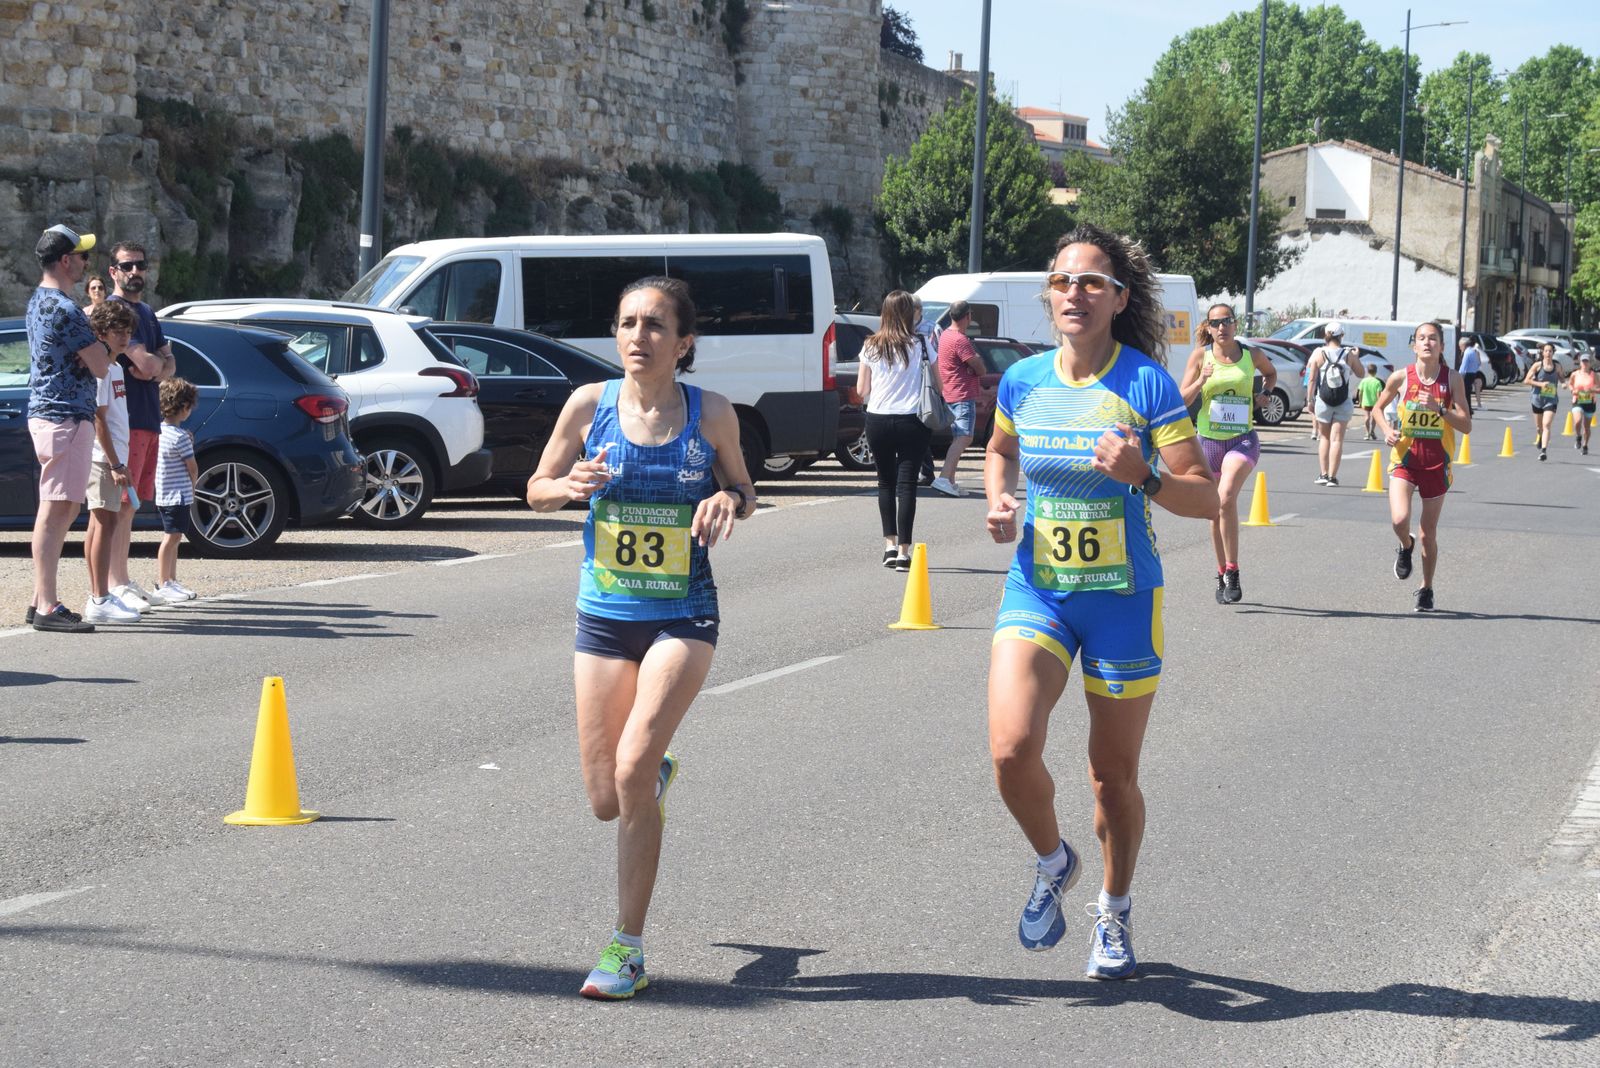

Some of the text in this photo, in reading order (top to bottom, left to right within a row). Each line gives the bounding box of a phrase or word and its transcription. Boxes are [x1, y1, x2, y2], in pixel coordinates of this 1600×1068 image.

[1222, 412, 1235, 422] ANA
[1408, 412, 1440, 427] 402
[622, 506, 678, 517] FUNDACION
[1055, 502, 1111, 511] FUNDACION
[622, 515, 678, 525] CAJA RURAL
[1055, 511, 1111, 519] CAJA RURAL
[616, 530, 665, 568] 83
[1052, 526, 1100, 562] 36
[1057, 572, 1121, 584] CAJA RURAL
[617, 578, 682, 590] CAJA RURAL
